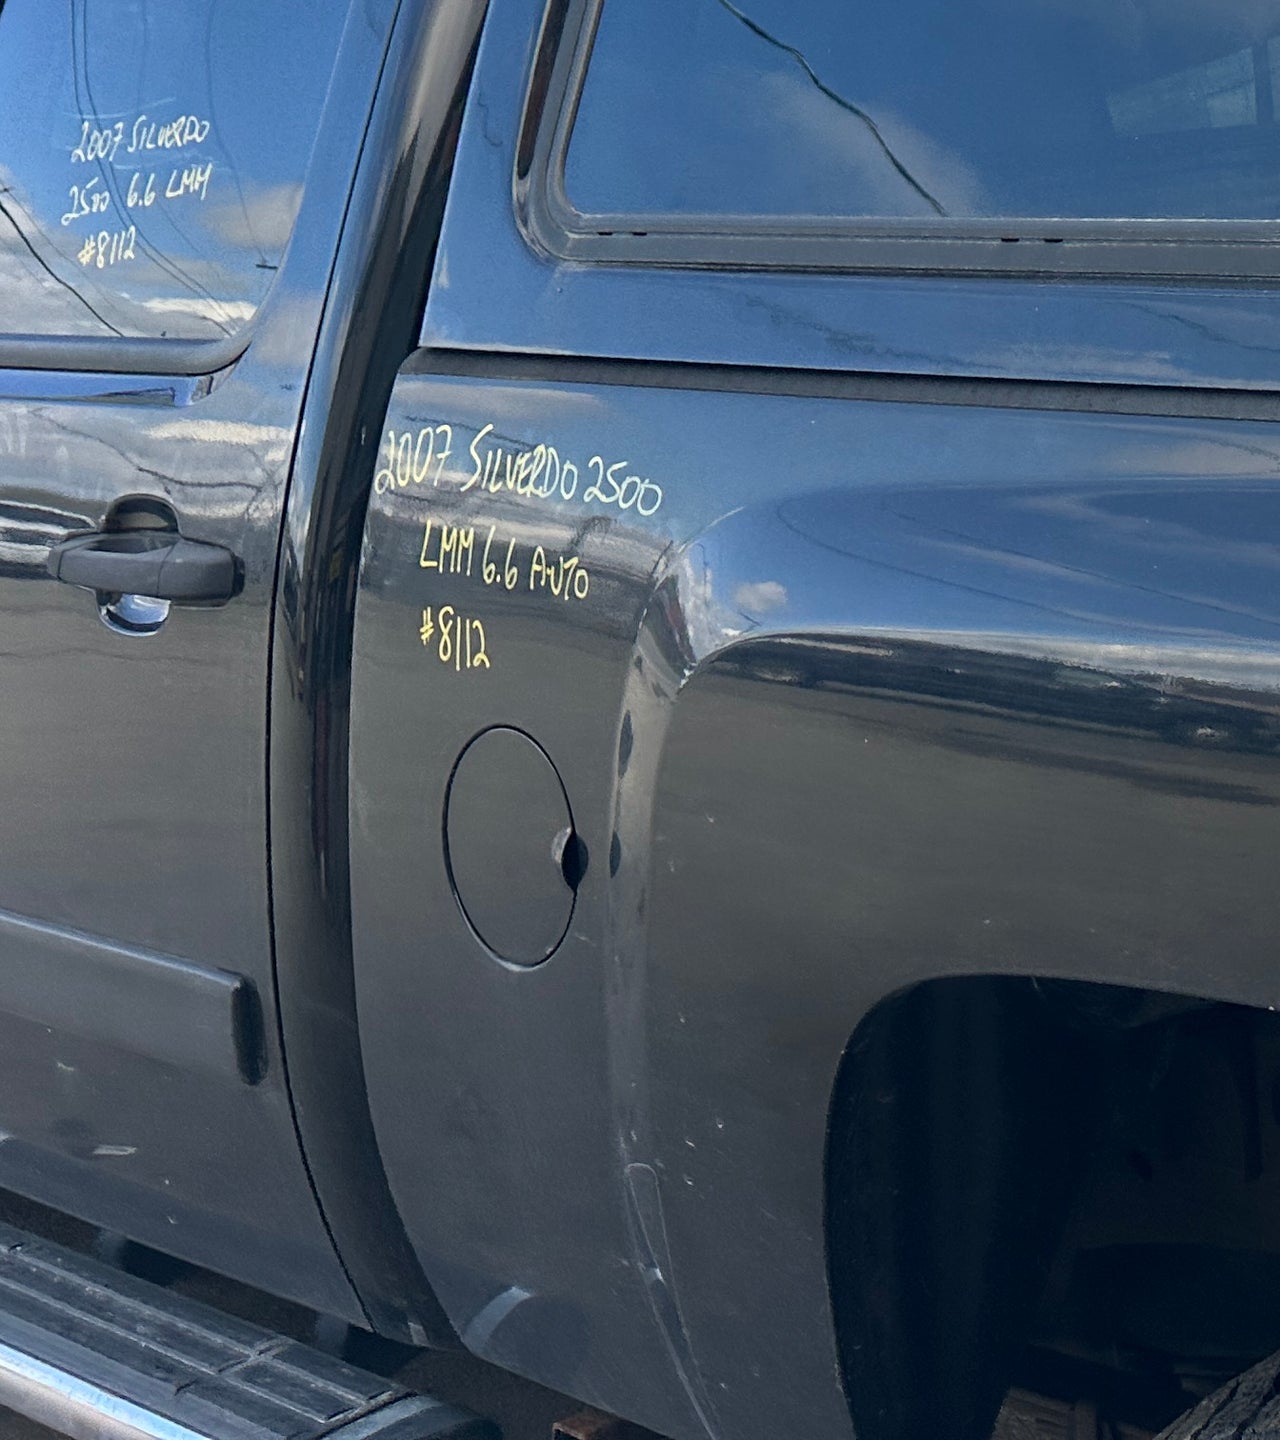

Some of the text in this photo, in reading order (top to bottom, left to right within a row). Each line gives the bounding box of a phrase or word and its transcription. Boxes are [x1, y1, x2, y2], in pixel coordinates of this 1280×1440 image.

[71, 120, 123, 162] 2007
[61, 163, 213, 226] 2500 6.6 LMM
[77, 225, 136, 268] #8112
[374, 424, 452, 494] 2007
[583, 456, 663, 516] 2500
[419, 520, 475, 576] LMM
[482, 525, 518, 590] 6.6
[419, 606, 490, 671] #8112
